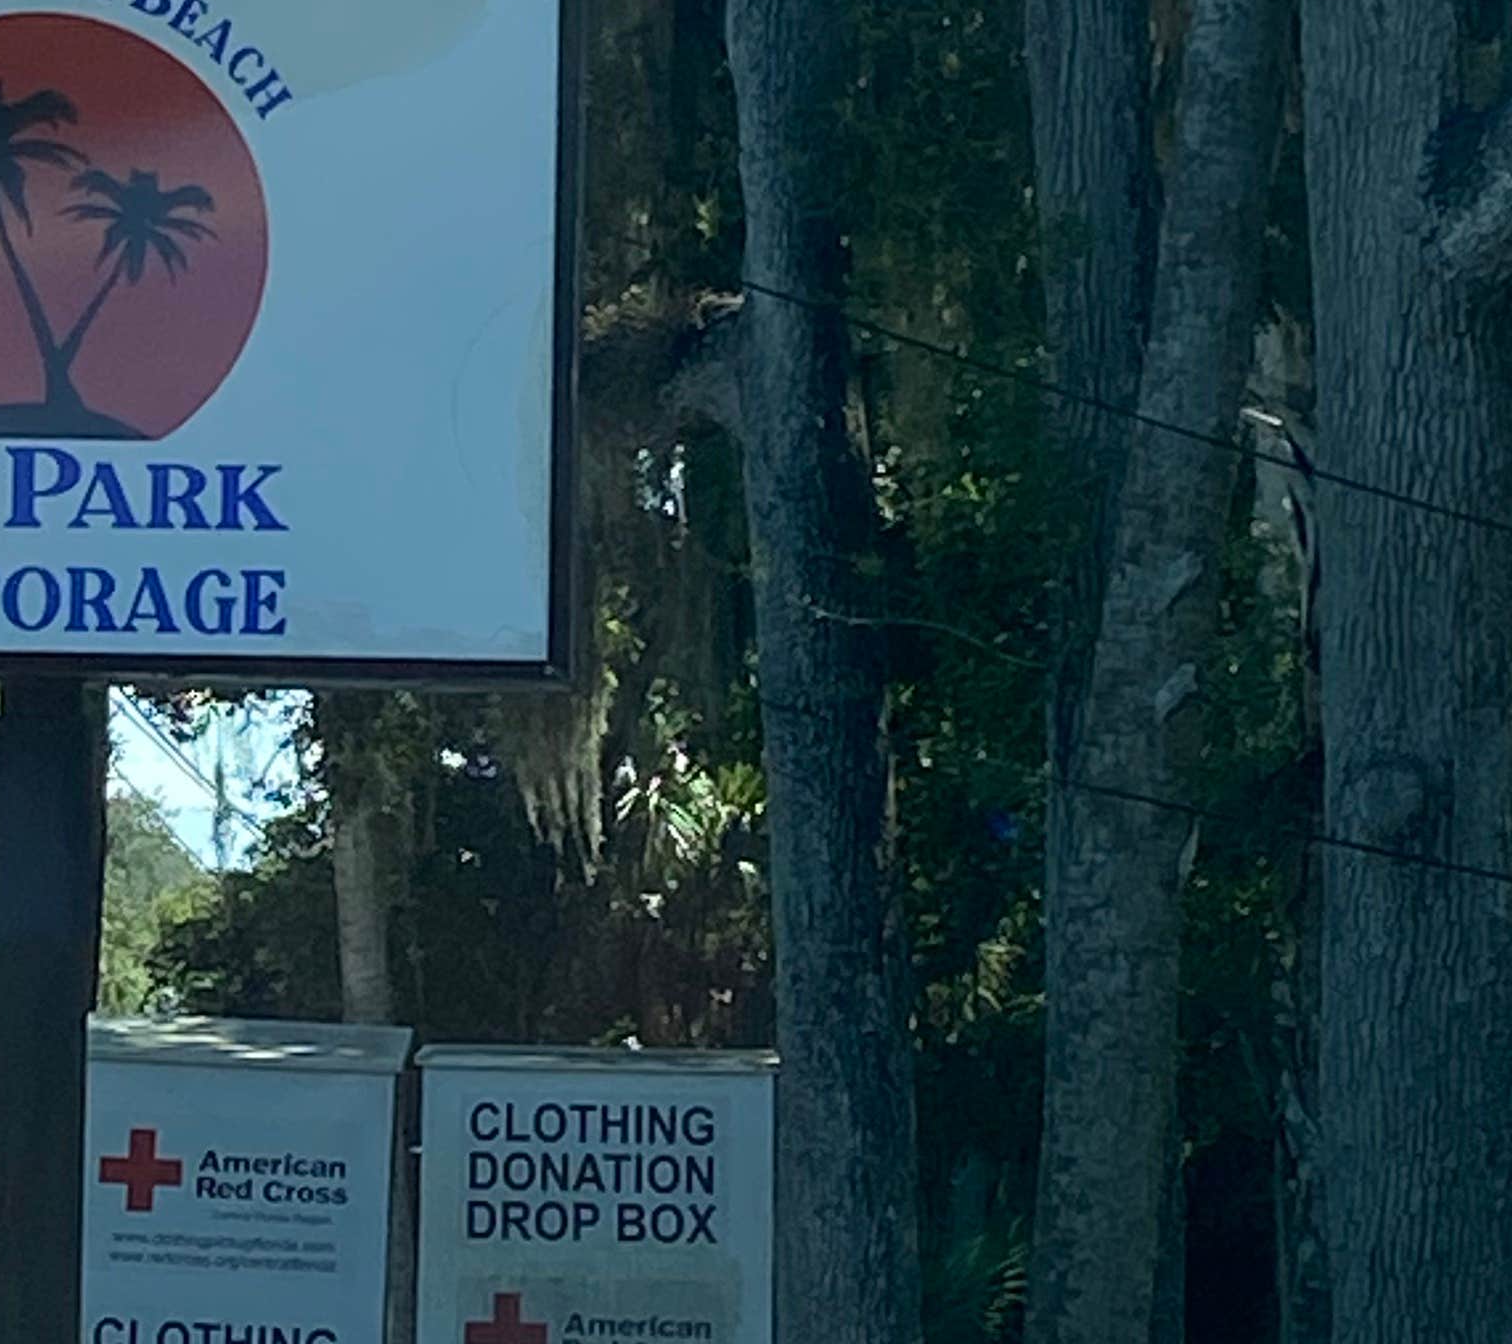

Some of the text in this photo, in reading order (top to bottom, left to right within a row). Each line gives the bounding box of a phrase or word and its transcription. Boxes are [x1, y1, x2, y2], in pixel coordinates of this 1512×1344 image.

[3, 445, 289, 531] PARK
[469, 1102, 716, 1146] CLOTHING
[198, 1150, 347, 1179] American
[467, 1151, 716, 1196] DONATION
[196, 1176, 348, 1205] Red Cross
[466, 1200, 718, 1244] DROP BOX
[564, 1312, 712, 1339] American
